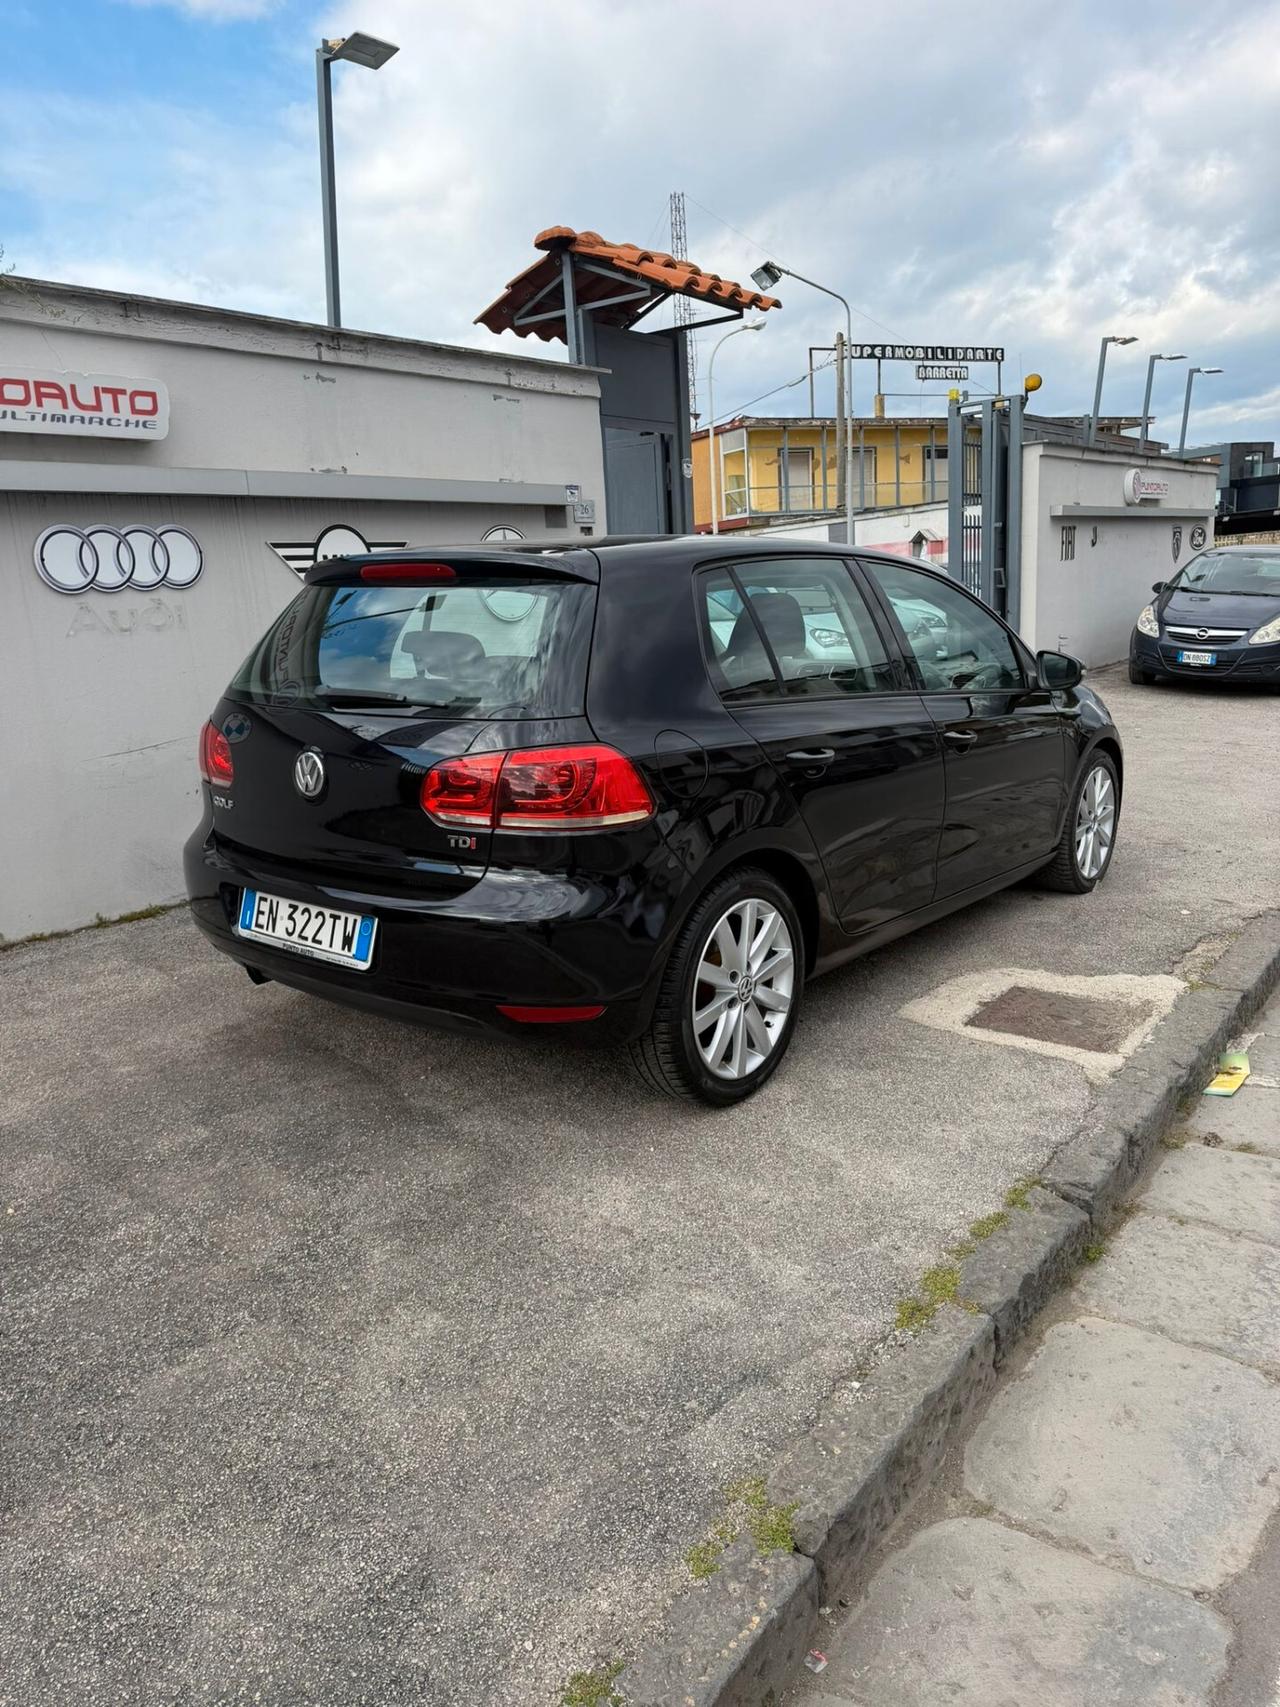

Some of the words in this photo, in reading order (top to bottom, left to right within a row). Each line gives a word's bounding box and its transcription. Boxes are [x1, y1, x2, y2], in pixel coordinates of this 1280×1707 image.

[918, 367, 968, 379] BARRETTA
[580, 503, 590, 515] 26
[1060, 525, 1077, 562] FIAT
[254, 896, 280, 933] EN
[285, 903, 358, 953] 322TW
